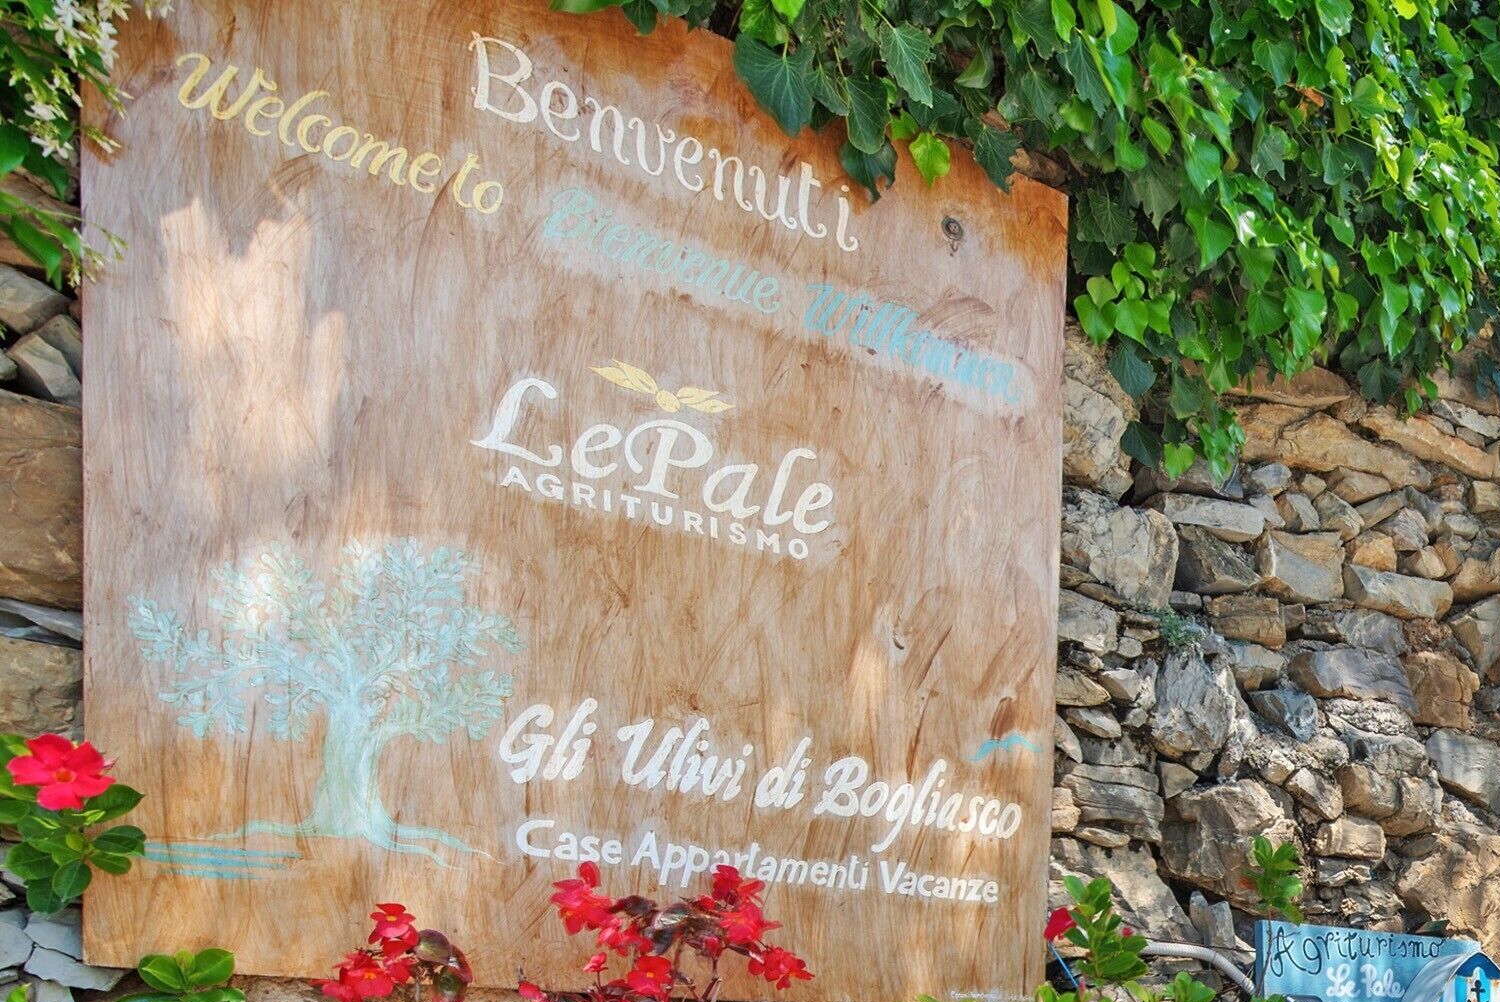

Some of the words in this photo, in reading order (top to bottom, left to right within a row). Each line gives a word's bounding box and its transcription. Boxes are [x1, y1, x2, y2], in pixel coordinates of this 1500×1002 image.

[176, 52, 442, 194] Welcome
[453, 151, 505, 215] to
[469, 30, 860, 252] Benvenuti
[543, 185, 782, 315] Bienvenue
[499, 465, 810, 561] AGRITURISMO
[499, 697, 598, 786] Gli
[617, 717, 754, 802] Ulivi
[755, 736, 812, 810] di
[814, 754, 1023, 853] Bogliasco
[515, 819, 622, 866] Case
[630, 830, 870, 890] Appartamenti
[879, 860, 1000, 904] Vacanze
[1270, 926, 1444, 977] Agriturismo
[1326, 963, 1361, 998] Le
[1361, 964, 1404, 999] Pale
